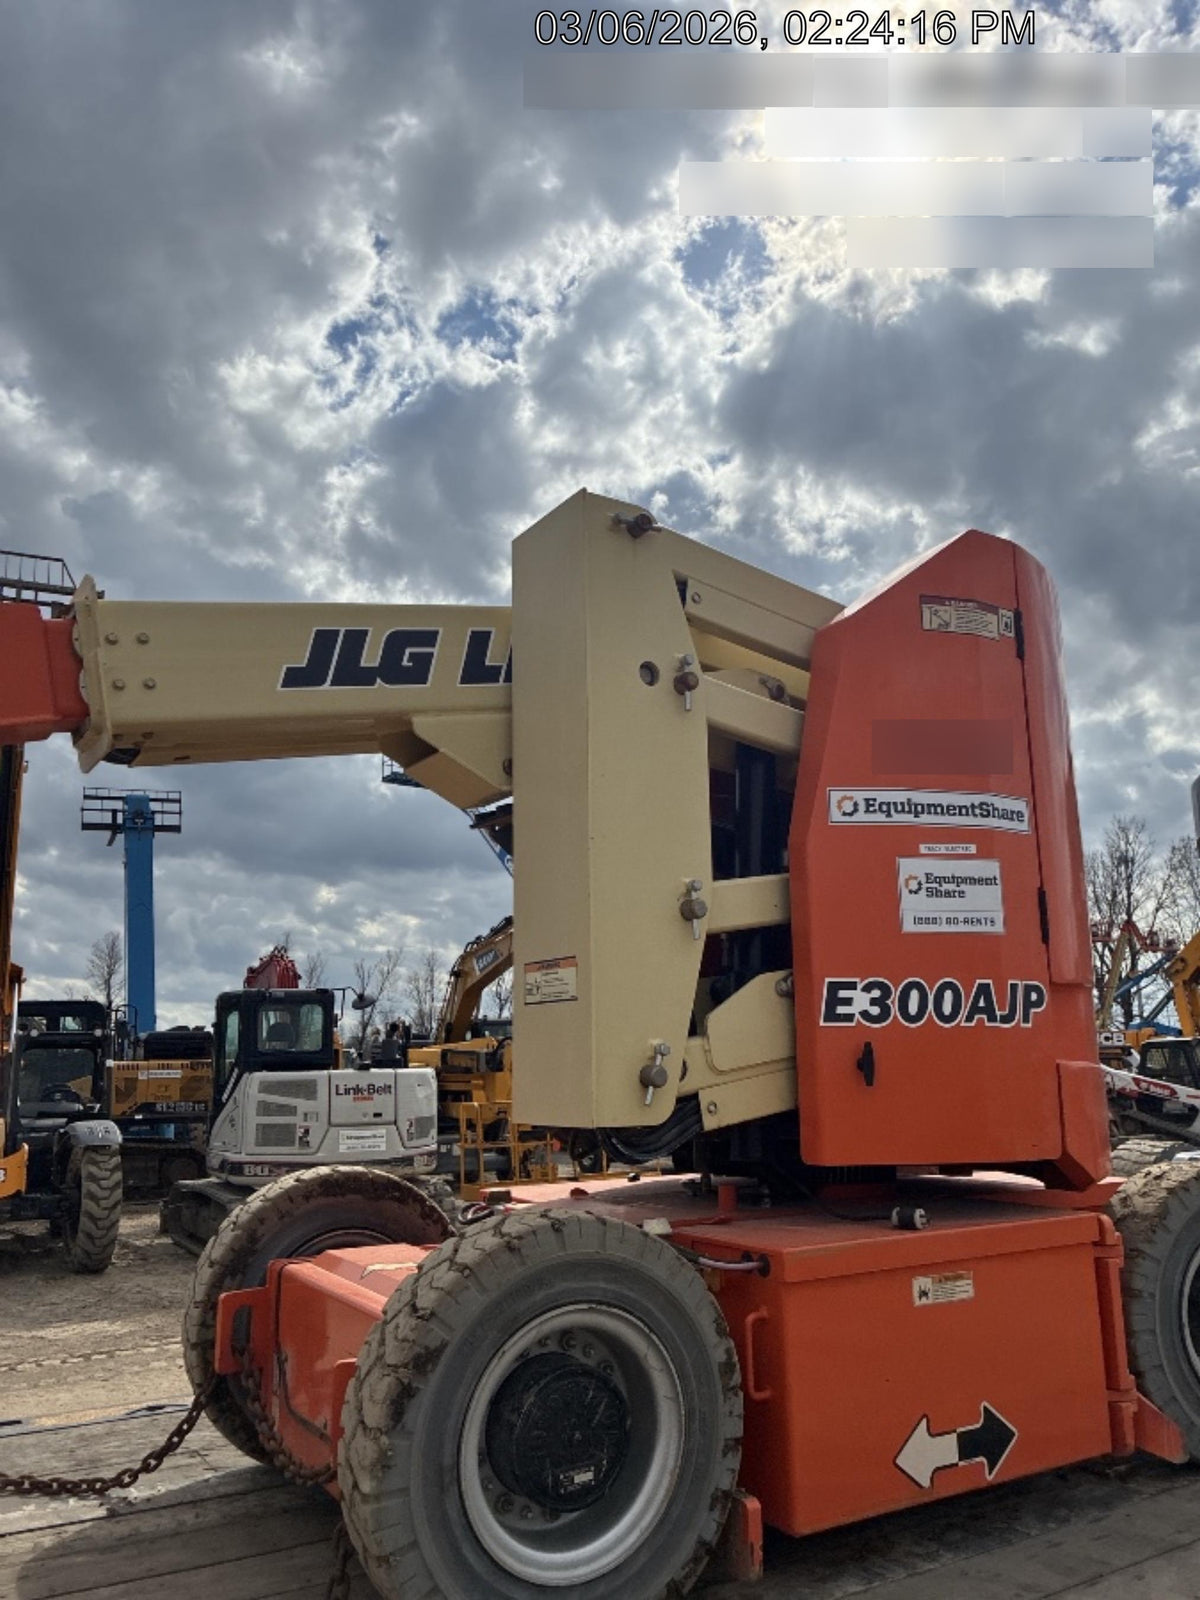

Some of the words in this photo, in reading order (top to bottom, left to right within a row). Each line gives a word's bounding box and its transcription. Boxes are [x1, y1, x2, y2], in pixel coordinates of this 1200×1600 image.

[277, 627, 442, 690] JLG
[457, 627, 512, 687] L
[862, 797, 1025, 823] EquipmentShare
[924, 872, 999, 888] Equipment
[925, 886, 966, 898] Share
[820, 977, 1047, 1028] E300AJP
[1097, 1032, 1125, 1046] CB
